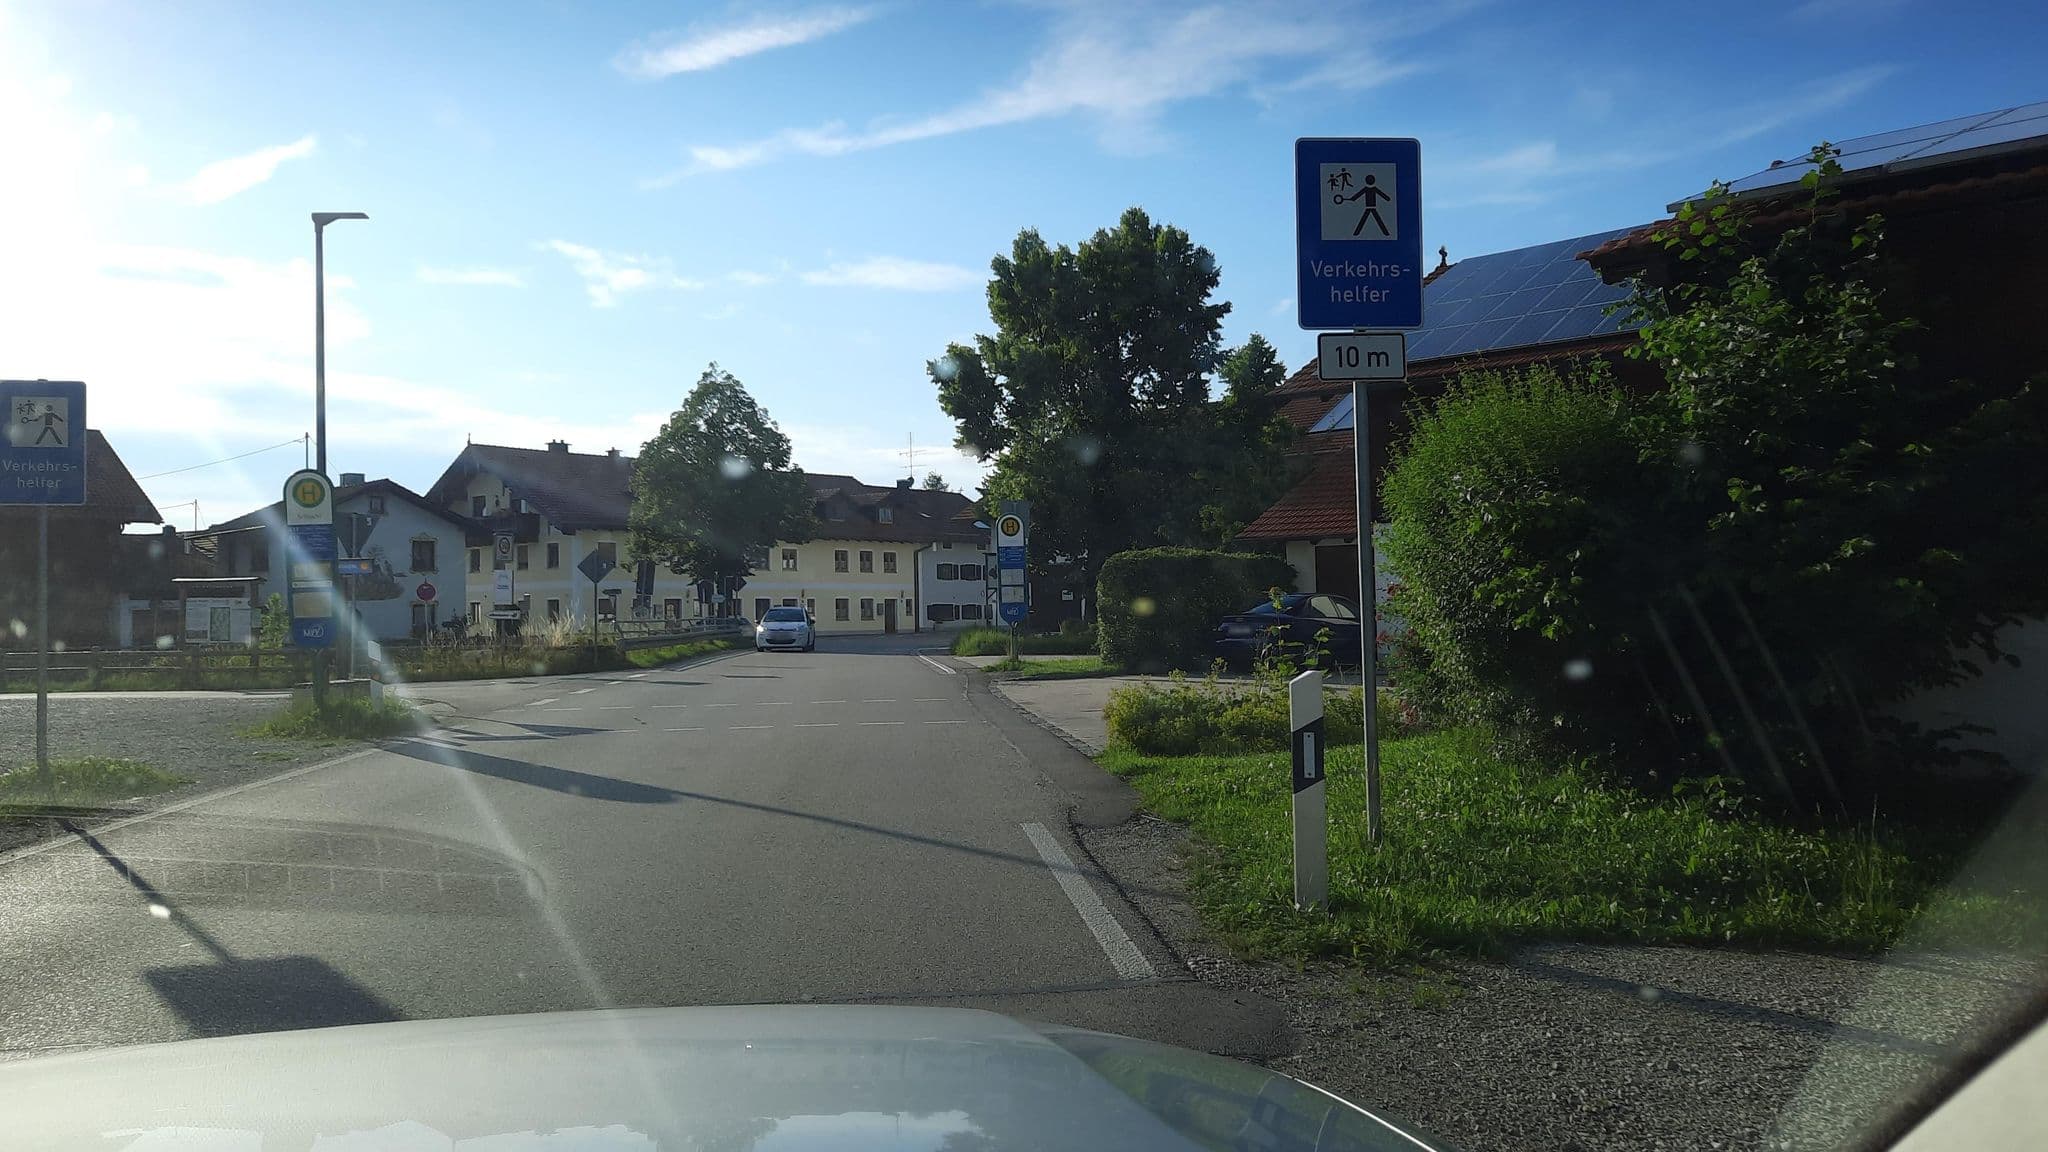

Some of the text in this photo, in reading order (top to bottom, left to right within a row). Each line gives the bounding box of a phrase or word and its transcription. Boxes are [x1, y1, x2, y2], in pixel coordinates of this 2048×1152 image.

[1310, 260, 1411, 278] Verkehrs-
[1330, 285, 1390, 302] helfer
[1335, 344, 1390, 368] 10 m
[2, 460, 78, 472] Verkehrs-
[17, 477, 62, 489] helfer
[302, 483, 315, 503] H
[1006, 521, 1015, 533] H
